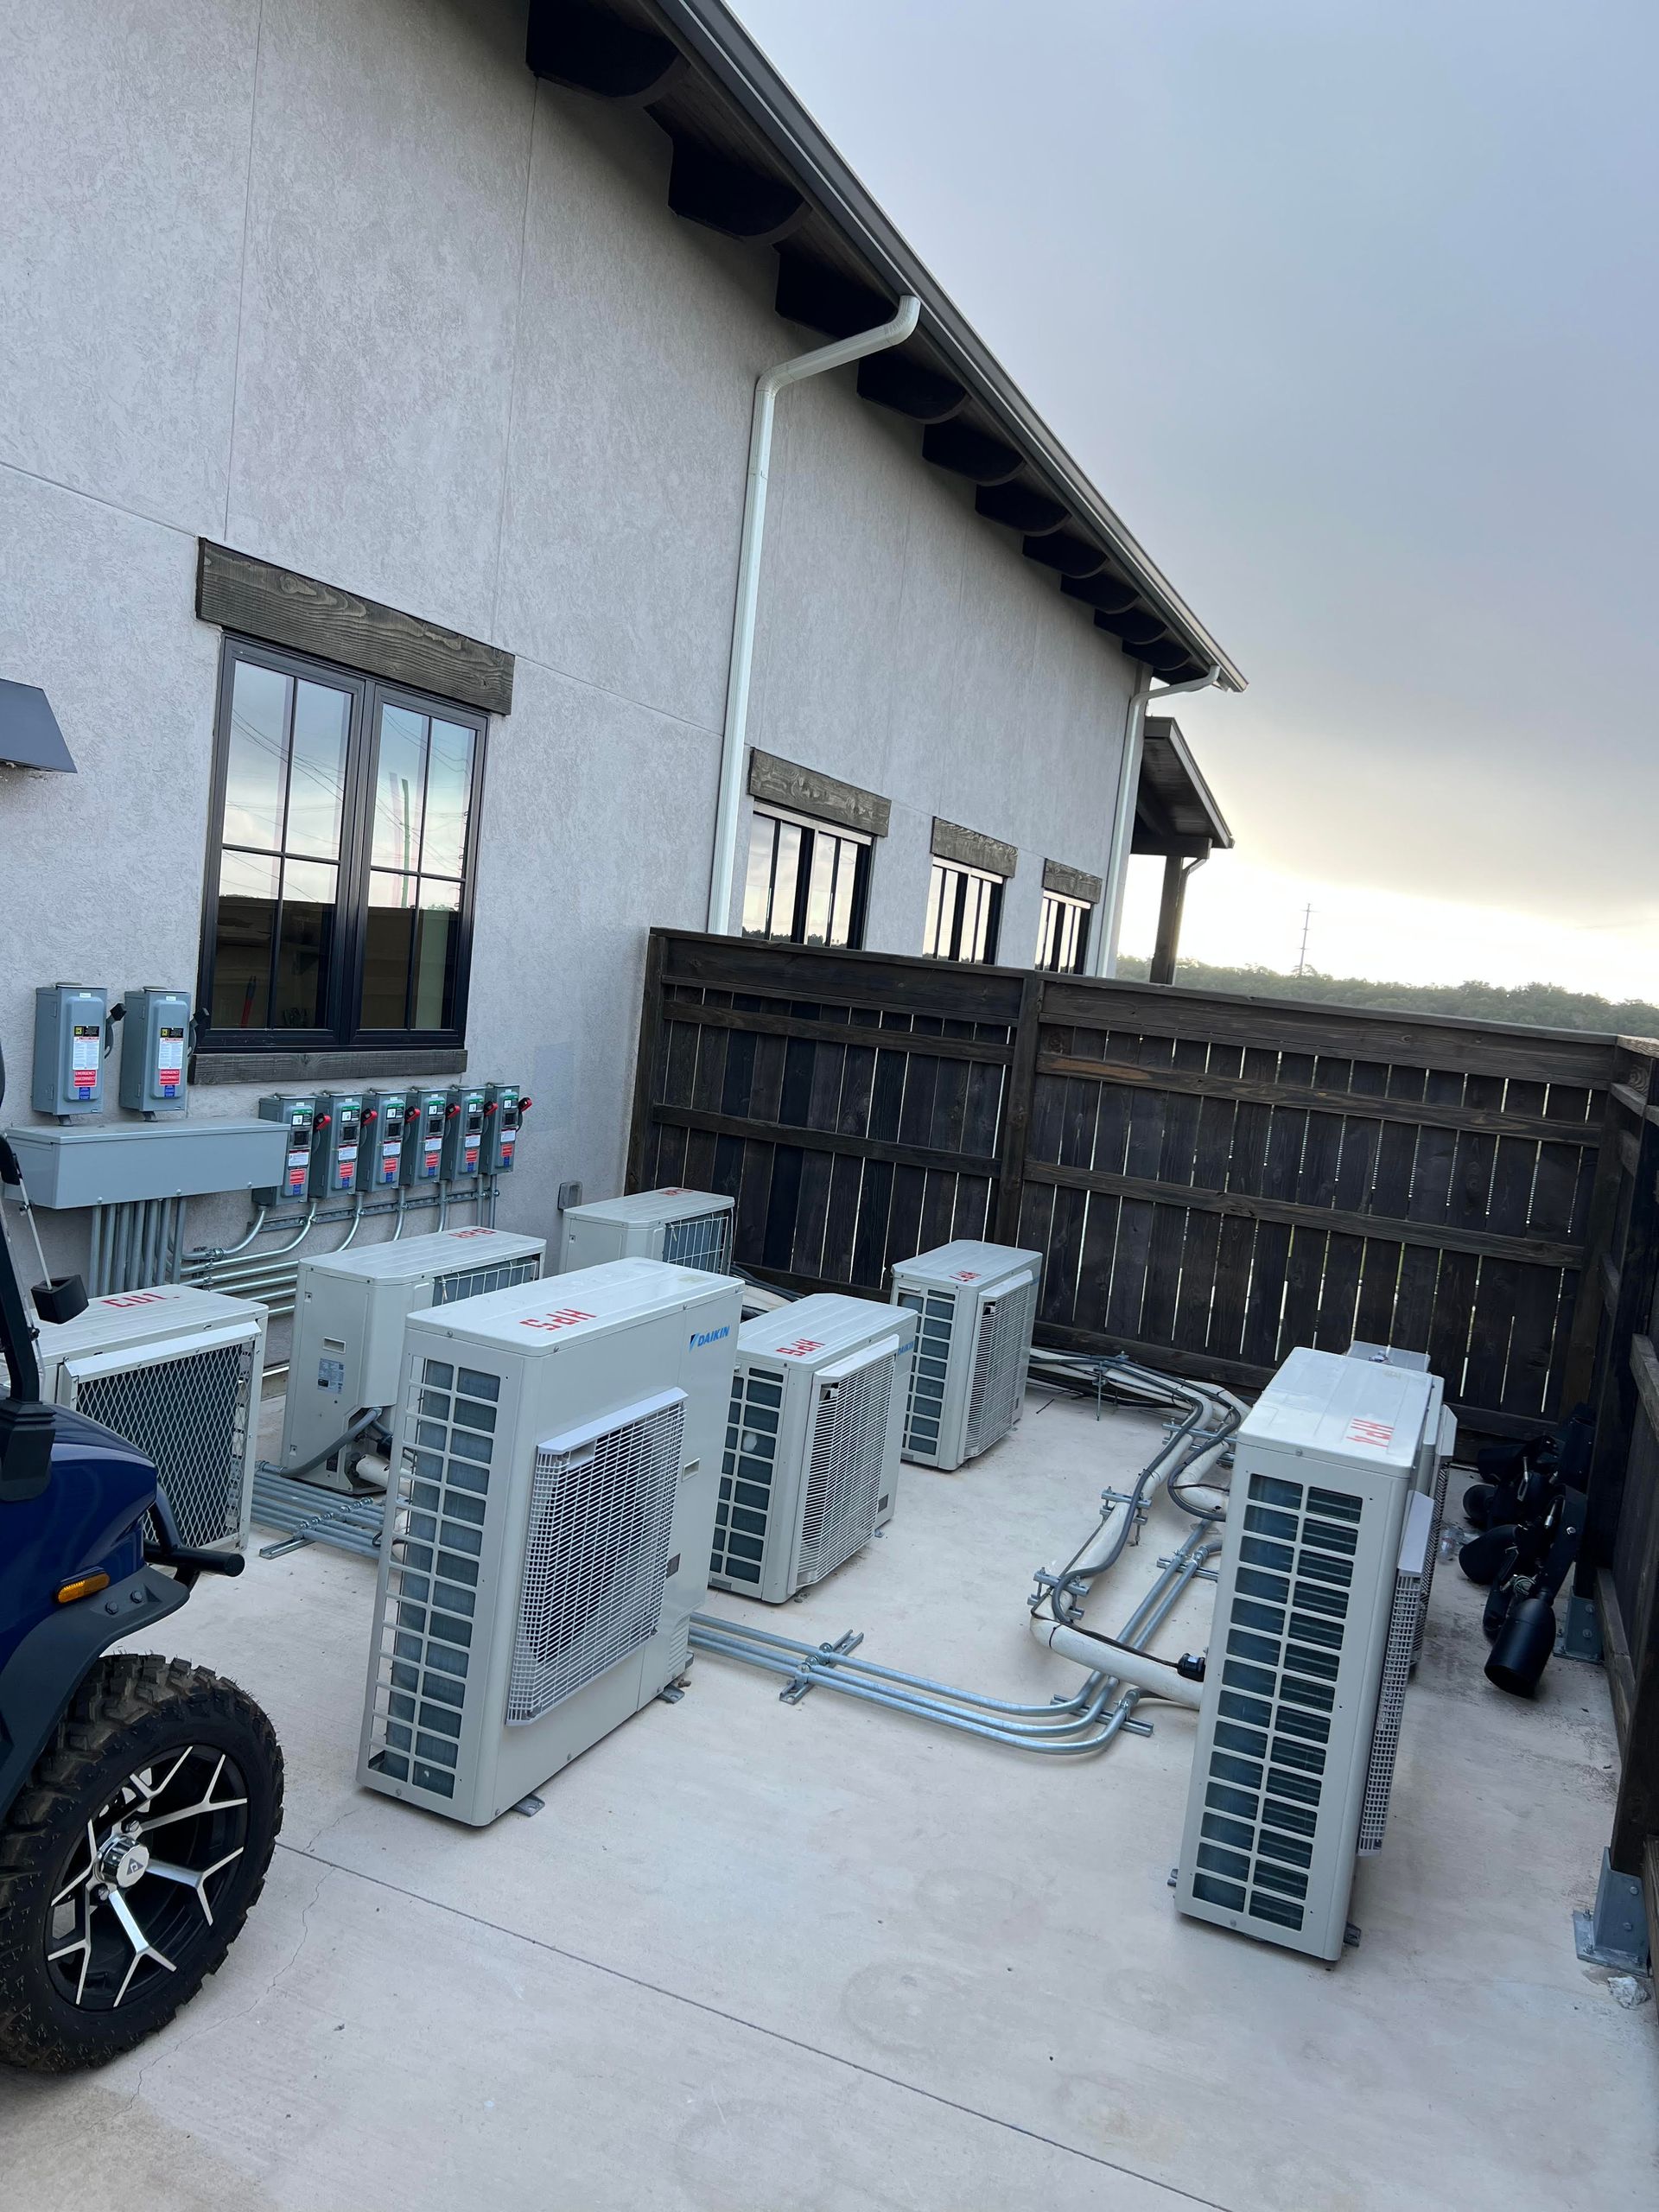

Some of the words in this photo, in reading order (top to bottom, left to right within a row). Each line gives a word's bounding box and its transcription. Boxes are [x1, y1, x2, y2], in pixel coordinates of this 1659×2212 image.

[519, 1308, 596, 1331] HP5
[697, 1325, 730, 1346] DAIKIN
[1345, 1418, 1395, 1447] HP4
